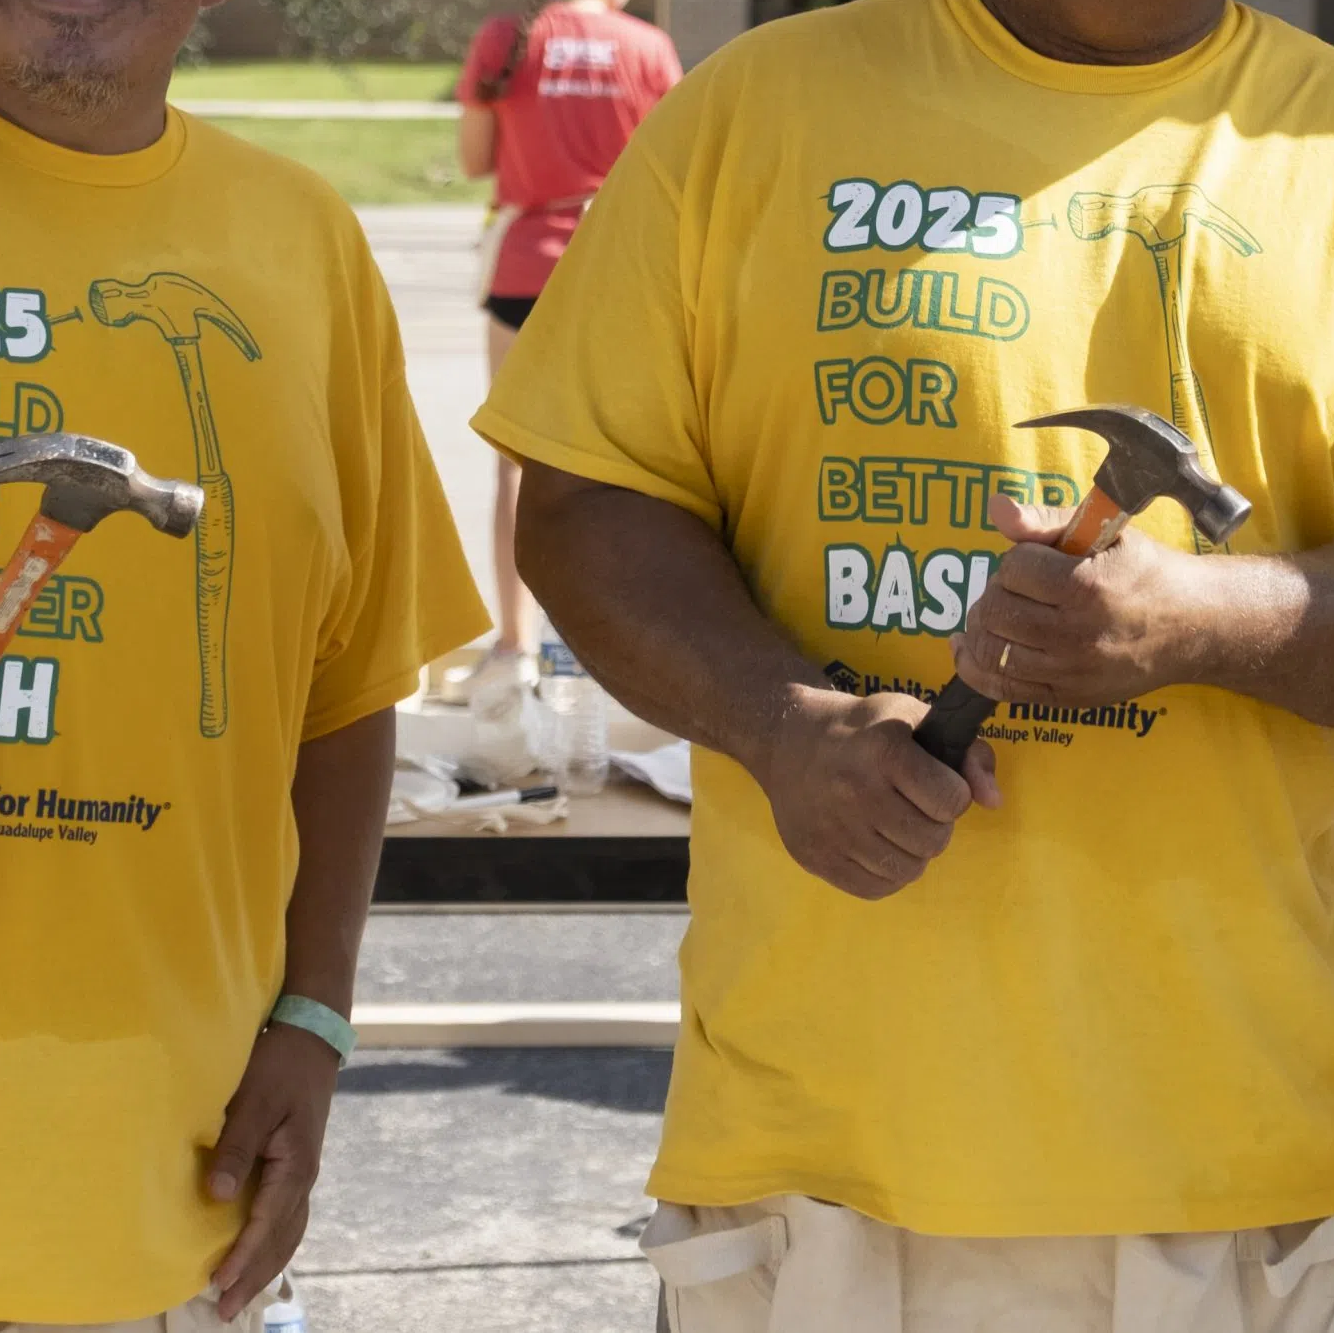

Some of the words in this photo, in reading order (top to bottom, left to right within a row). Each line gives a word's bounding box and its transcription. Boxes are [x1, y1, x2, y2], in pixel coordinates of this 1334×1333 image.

[824, 179, 1022, 257] 2025
[816, 269, 1029, 341] BUILD
[814, 357, 957, 427] FOR
[865, 675, 948, 705] Hbita
[979, 726, 1028, 743] adalupe
[1034, 727, 1074, 745] Valley
[58, 824, 98, 846] Valley
